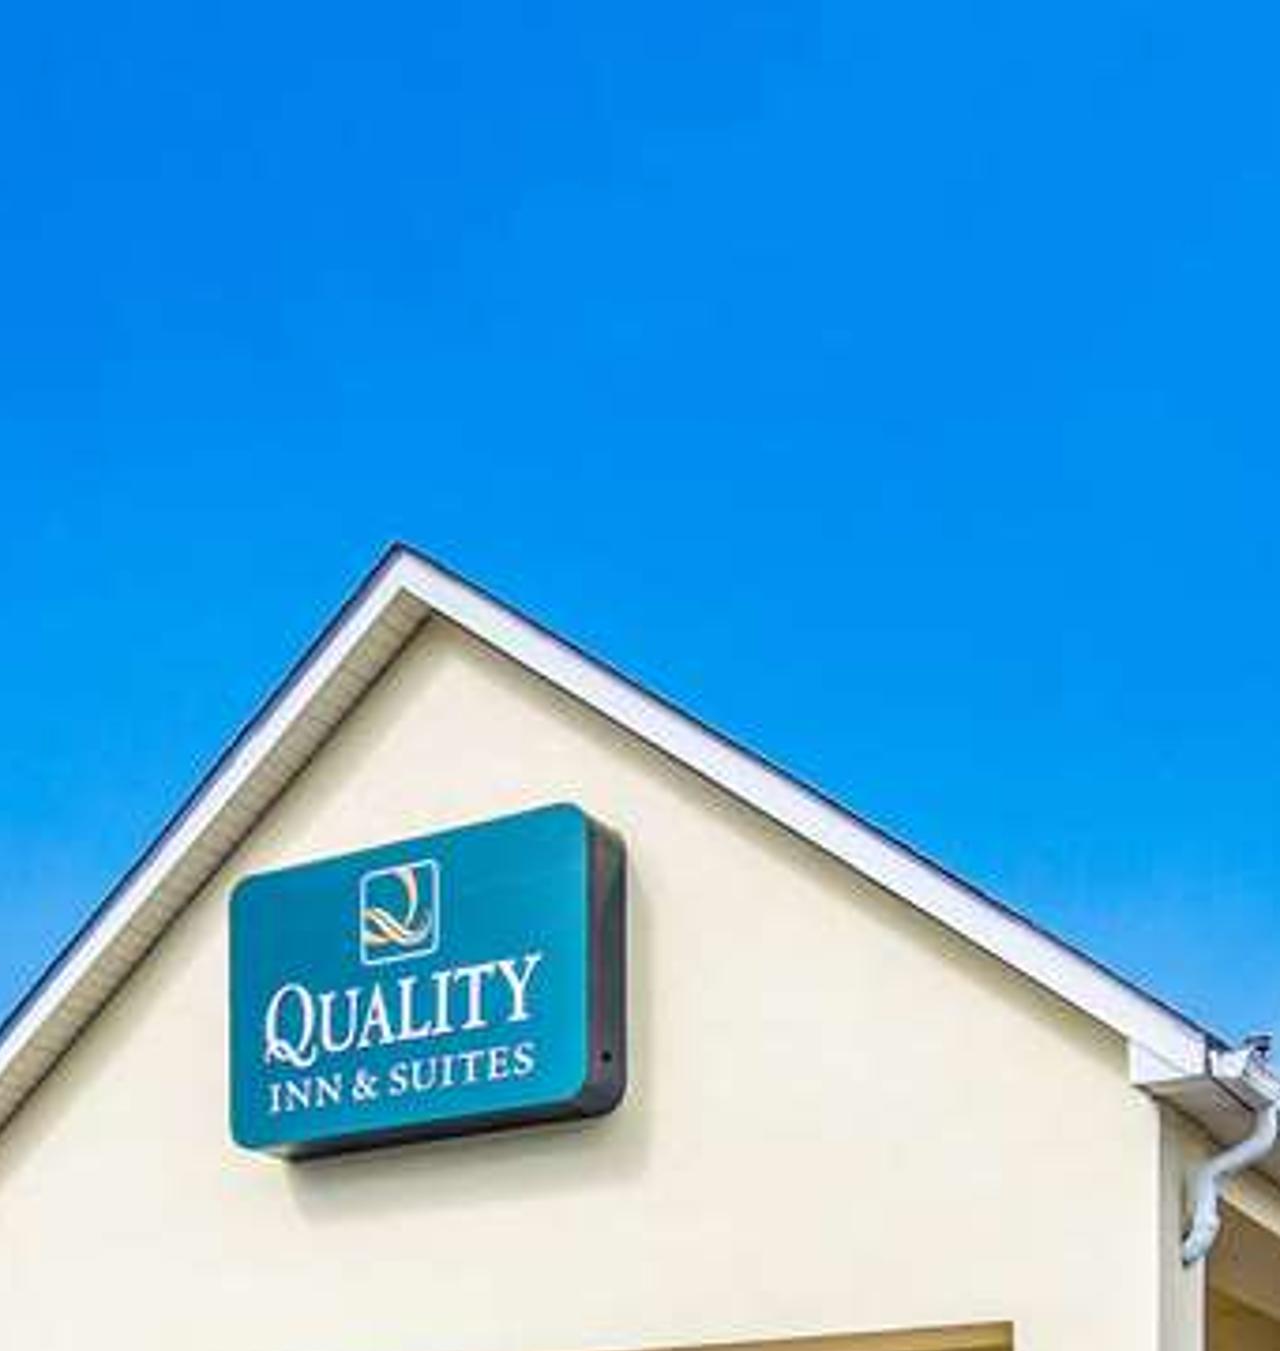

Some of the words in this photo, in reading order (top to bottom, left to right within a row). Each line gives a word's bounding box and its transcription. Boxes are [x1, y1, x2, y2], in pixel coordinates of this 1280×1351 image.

[265, 954, 542, 1067] QUALITY
[269, 1075, 343, 1112] INN
[352, 1073, 377, 1100] &
[389, 1042, 534, 1096] SUITES
